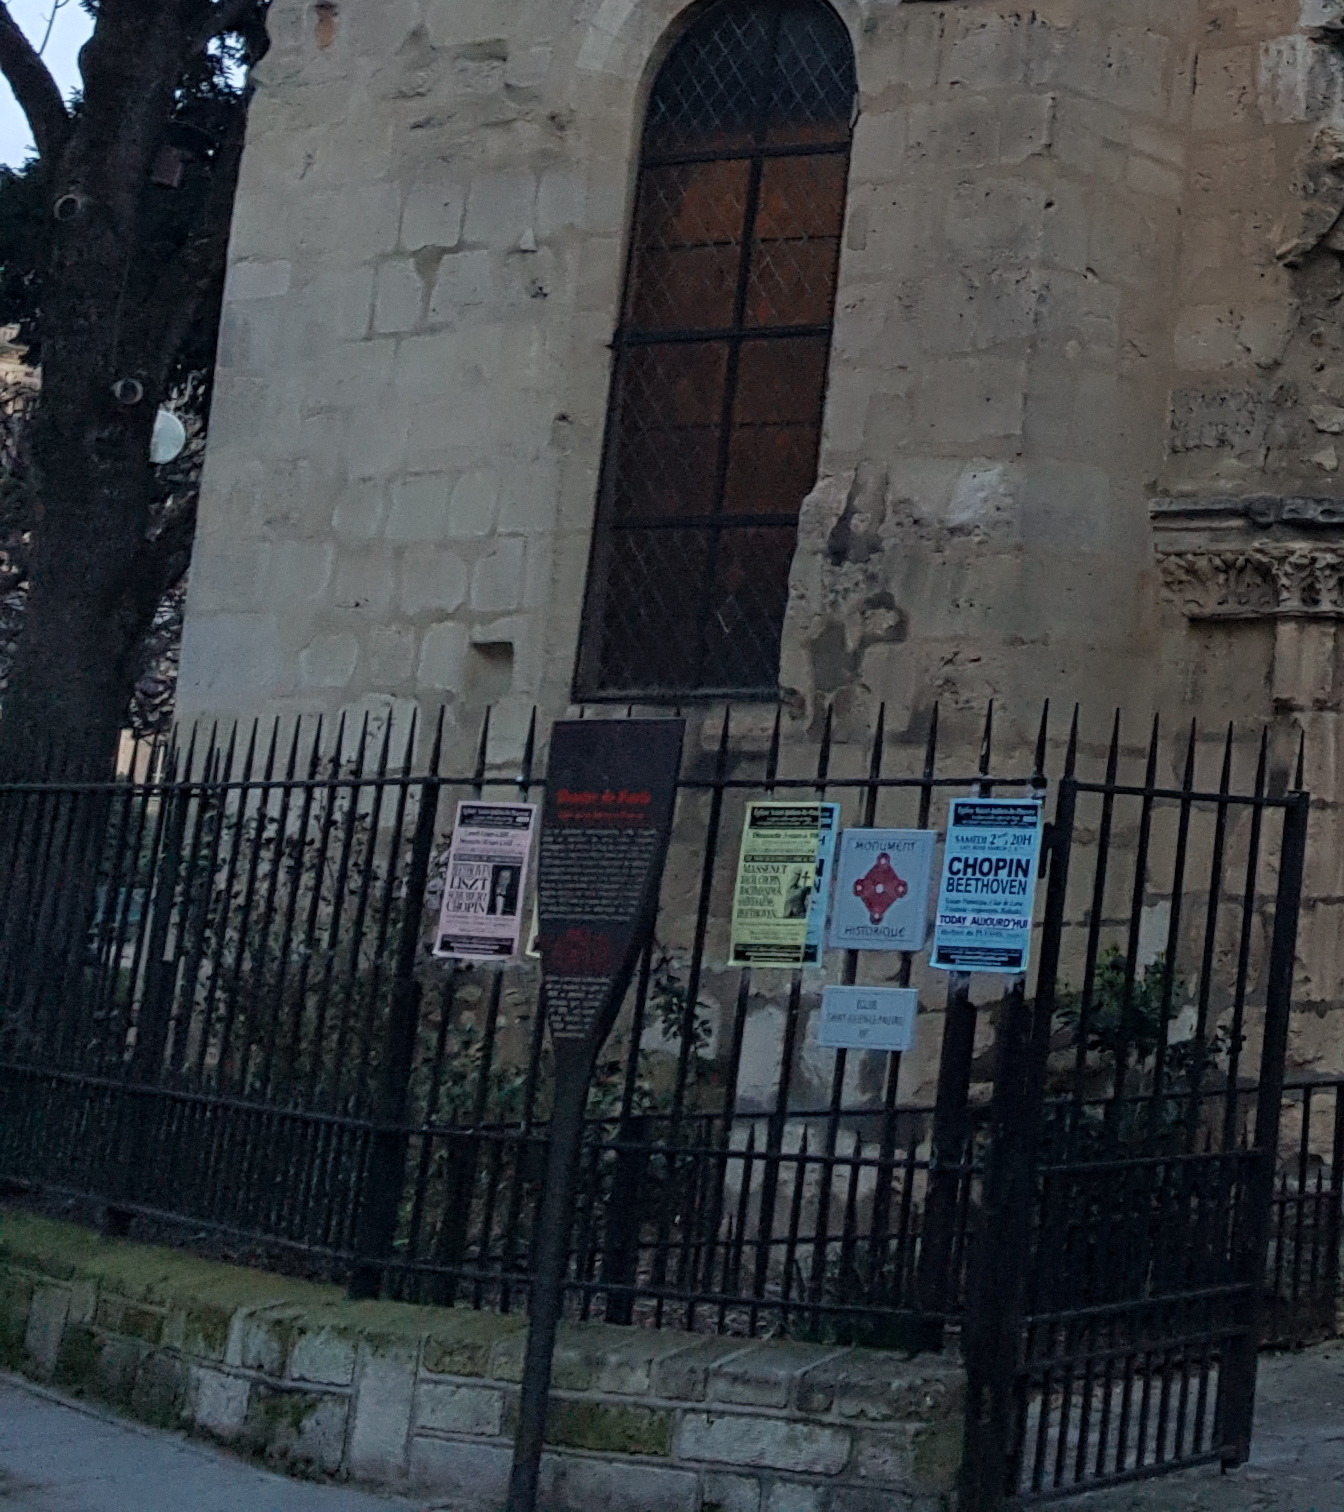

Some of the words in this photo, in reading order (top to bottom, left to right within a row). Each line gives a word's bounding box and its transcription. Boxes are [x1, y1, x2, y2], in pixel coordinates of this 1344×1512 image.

[990, 834, 996, 845] 2
[1010, 834, 1032, 845] 20H
[855, 841, 917, 852] MONUMENT
[948, 856, 1030, 878] CHOPIN
[451, 878, 489, 890] LISZT
[946, 877, 1027, 895] BEETHOVEN
[446, 902, 485, 913] CHOPIN
[940, 915, 967, 924] TODAY
[845, 926, 906, 937] HISTORIQUE
